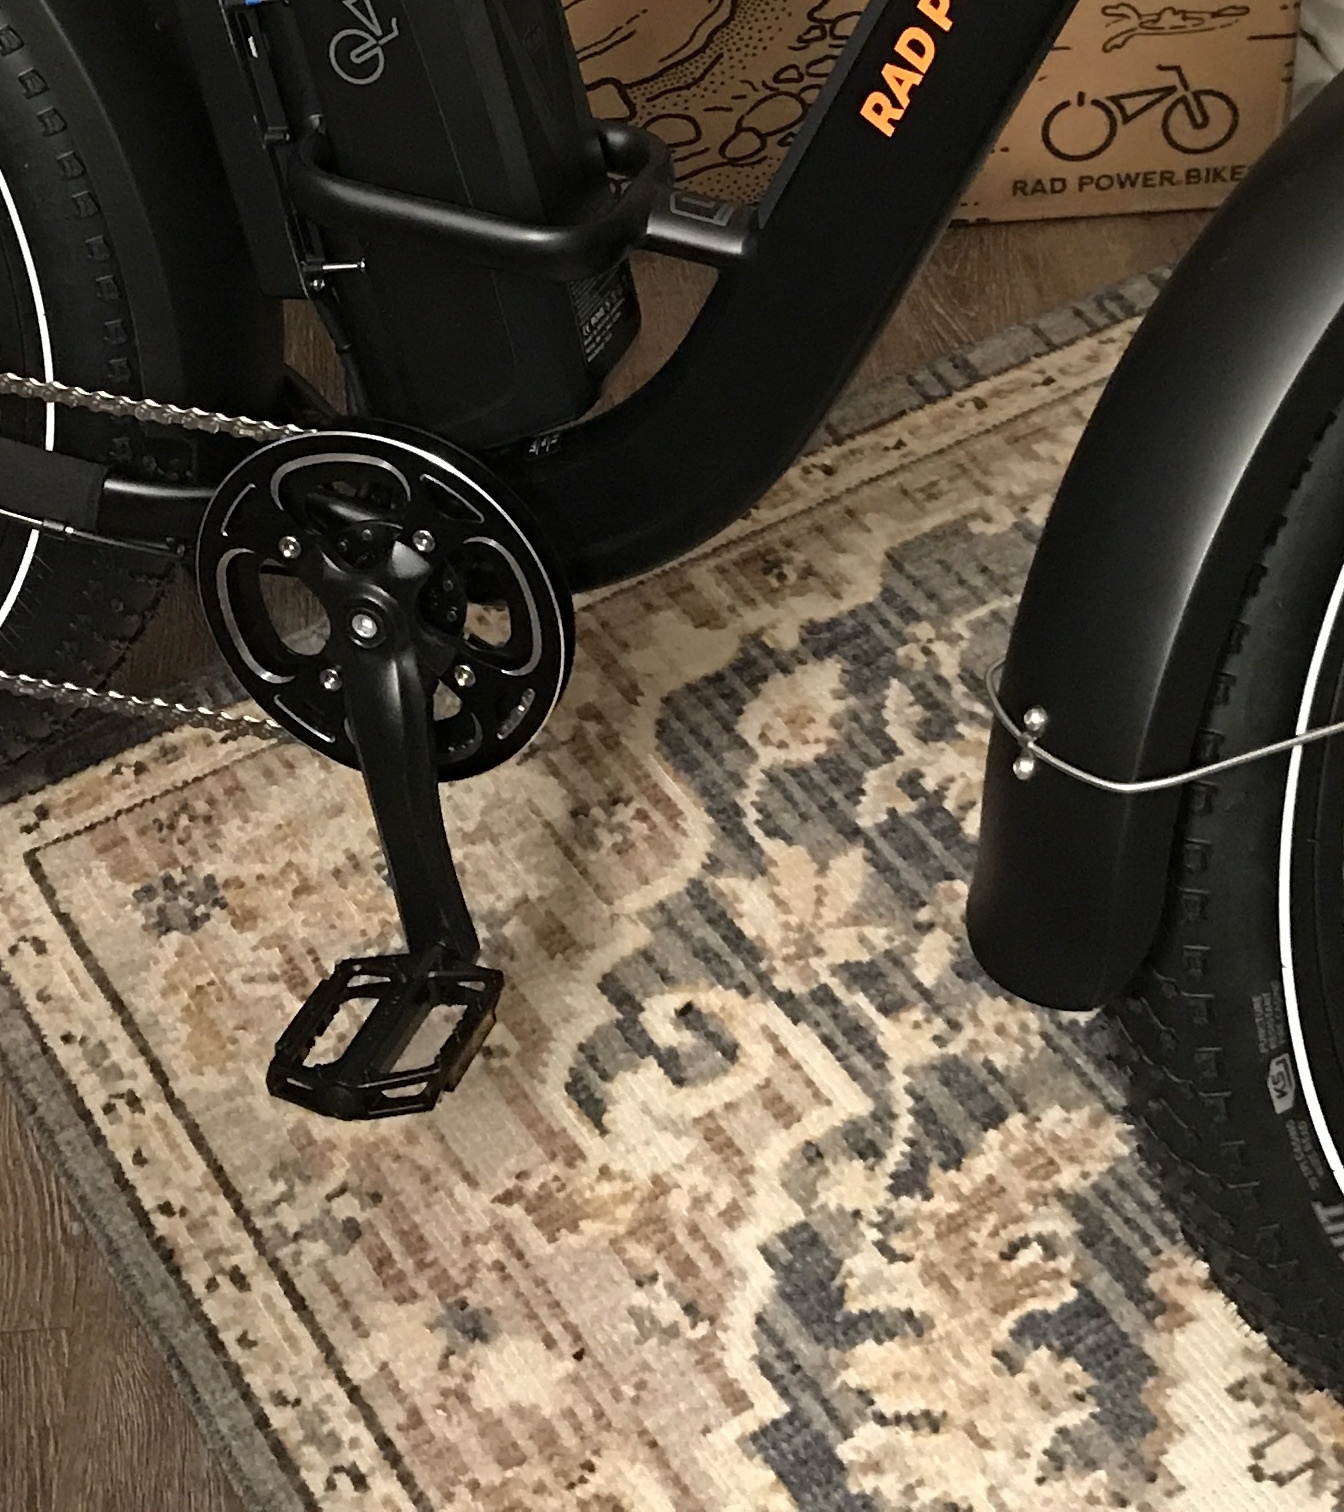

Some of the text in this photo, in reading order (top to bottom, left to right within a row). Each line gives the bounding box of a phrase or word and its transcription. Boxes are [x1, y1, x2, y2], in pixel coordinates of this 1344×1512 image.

[859, 23, 936, 138] RAD
[1013, 164, 1246, 198] RAD POWER BIKE
